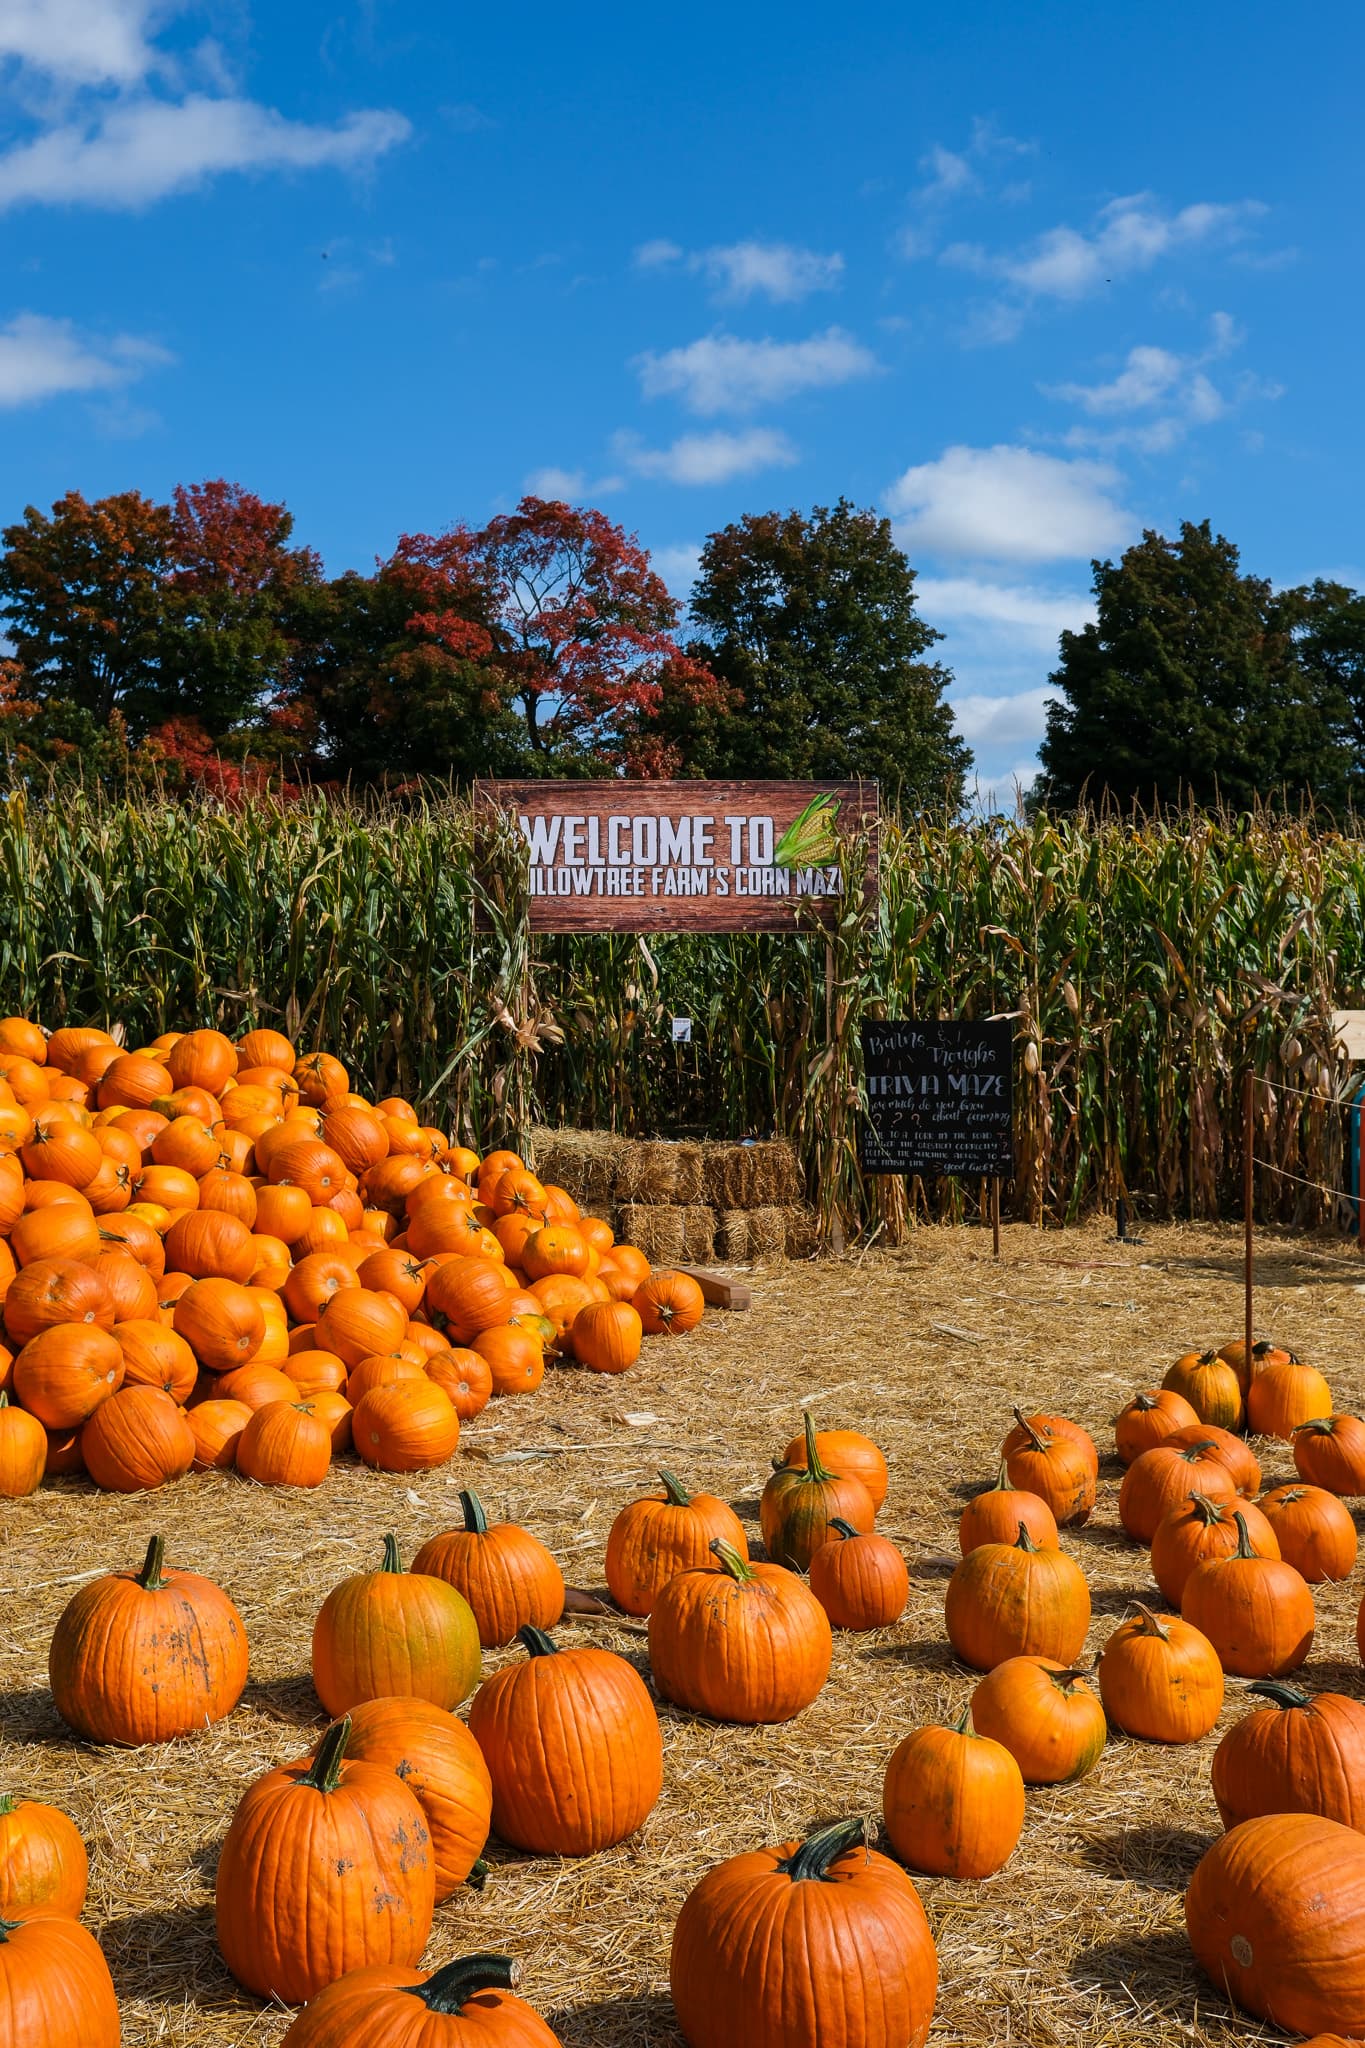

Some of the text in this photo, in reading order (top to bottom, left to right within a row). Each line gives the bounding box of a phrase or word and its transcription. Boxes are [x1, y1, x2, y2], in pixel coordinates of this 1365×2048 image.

[519, 815, 774, 866] WELCOME TO
[528, 867, 645, 896] ILLOWTREE
[652, 867, 729, 896] FARM'S
[736, 867, 790, 896] CORN
[926, 1040, 997, 1069] Troughs
[865, 1073, 1009, 1097] TRIVIA MAZE
[918, 1097, 930, 1111] do
[935, 1100, 955, 1113] you
[959, 1099, 985, 1111] know
[931, 1109, 1011, 1127] about farming
